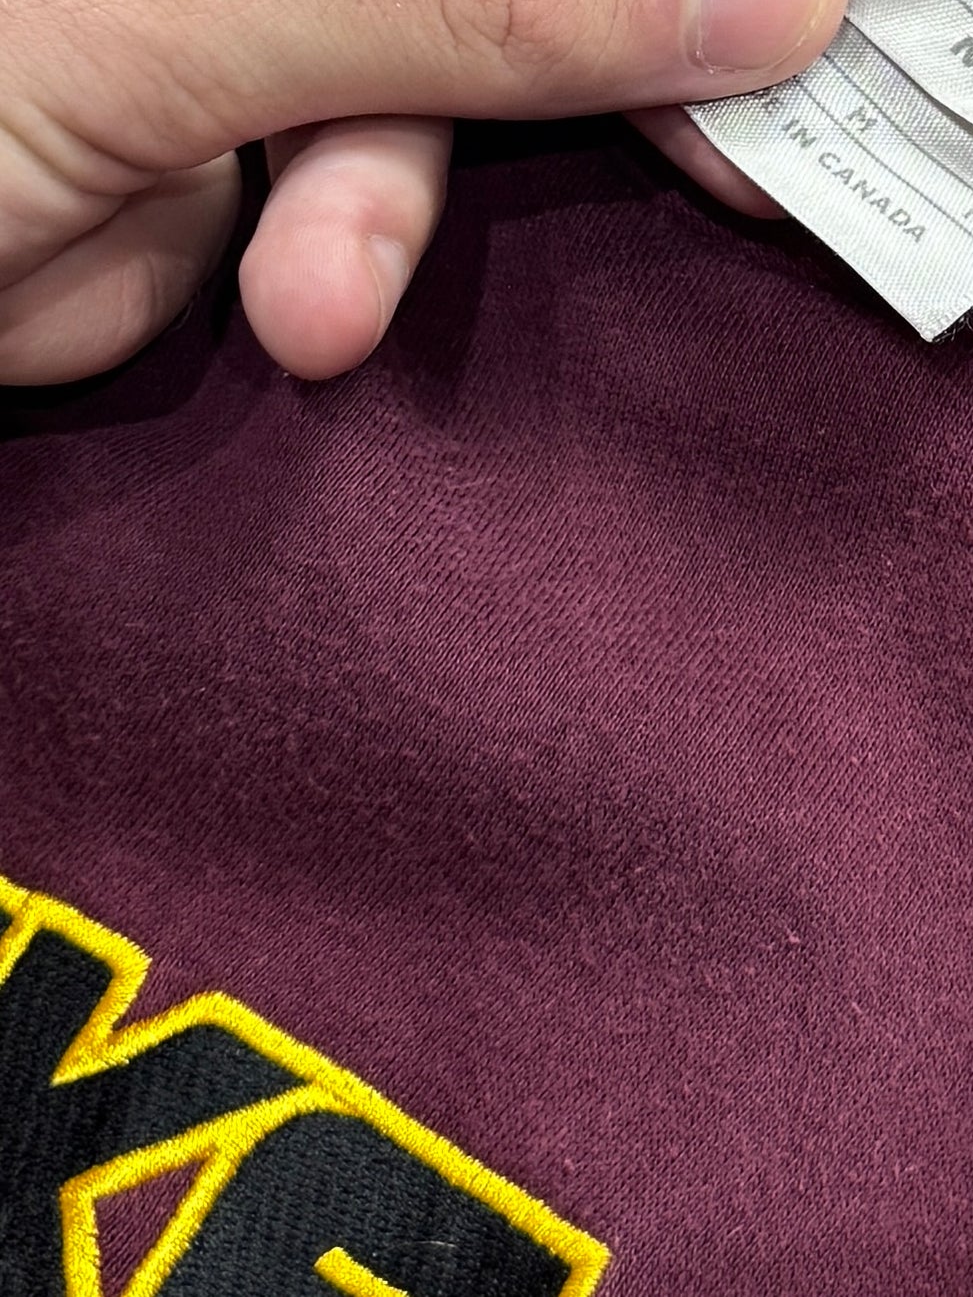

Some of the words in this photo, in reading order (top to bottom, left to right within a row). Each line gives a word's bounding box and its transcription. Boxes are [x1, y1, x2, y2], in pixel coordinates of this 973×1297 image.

[846, 105, 878, 133] M
[781, 119, 818, 148] IN
[817, 151, 927, 244] CANADA
